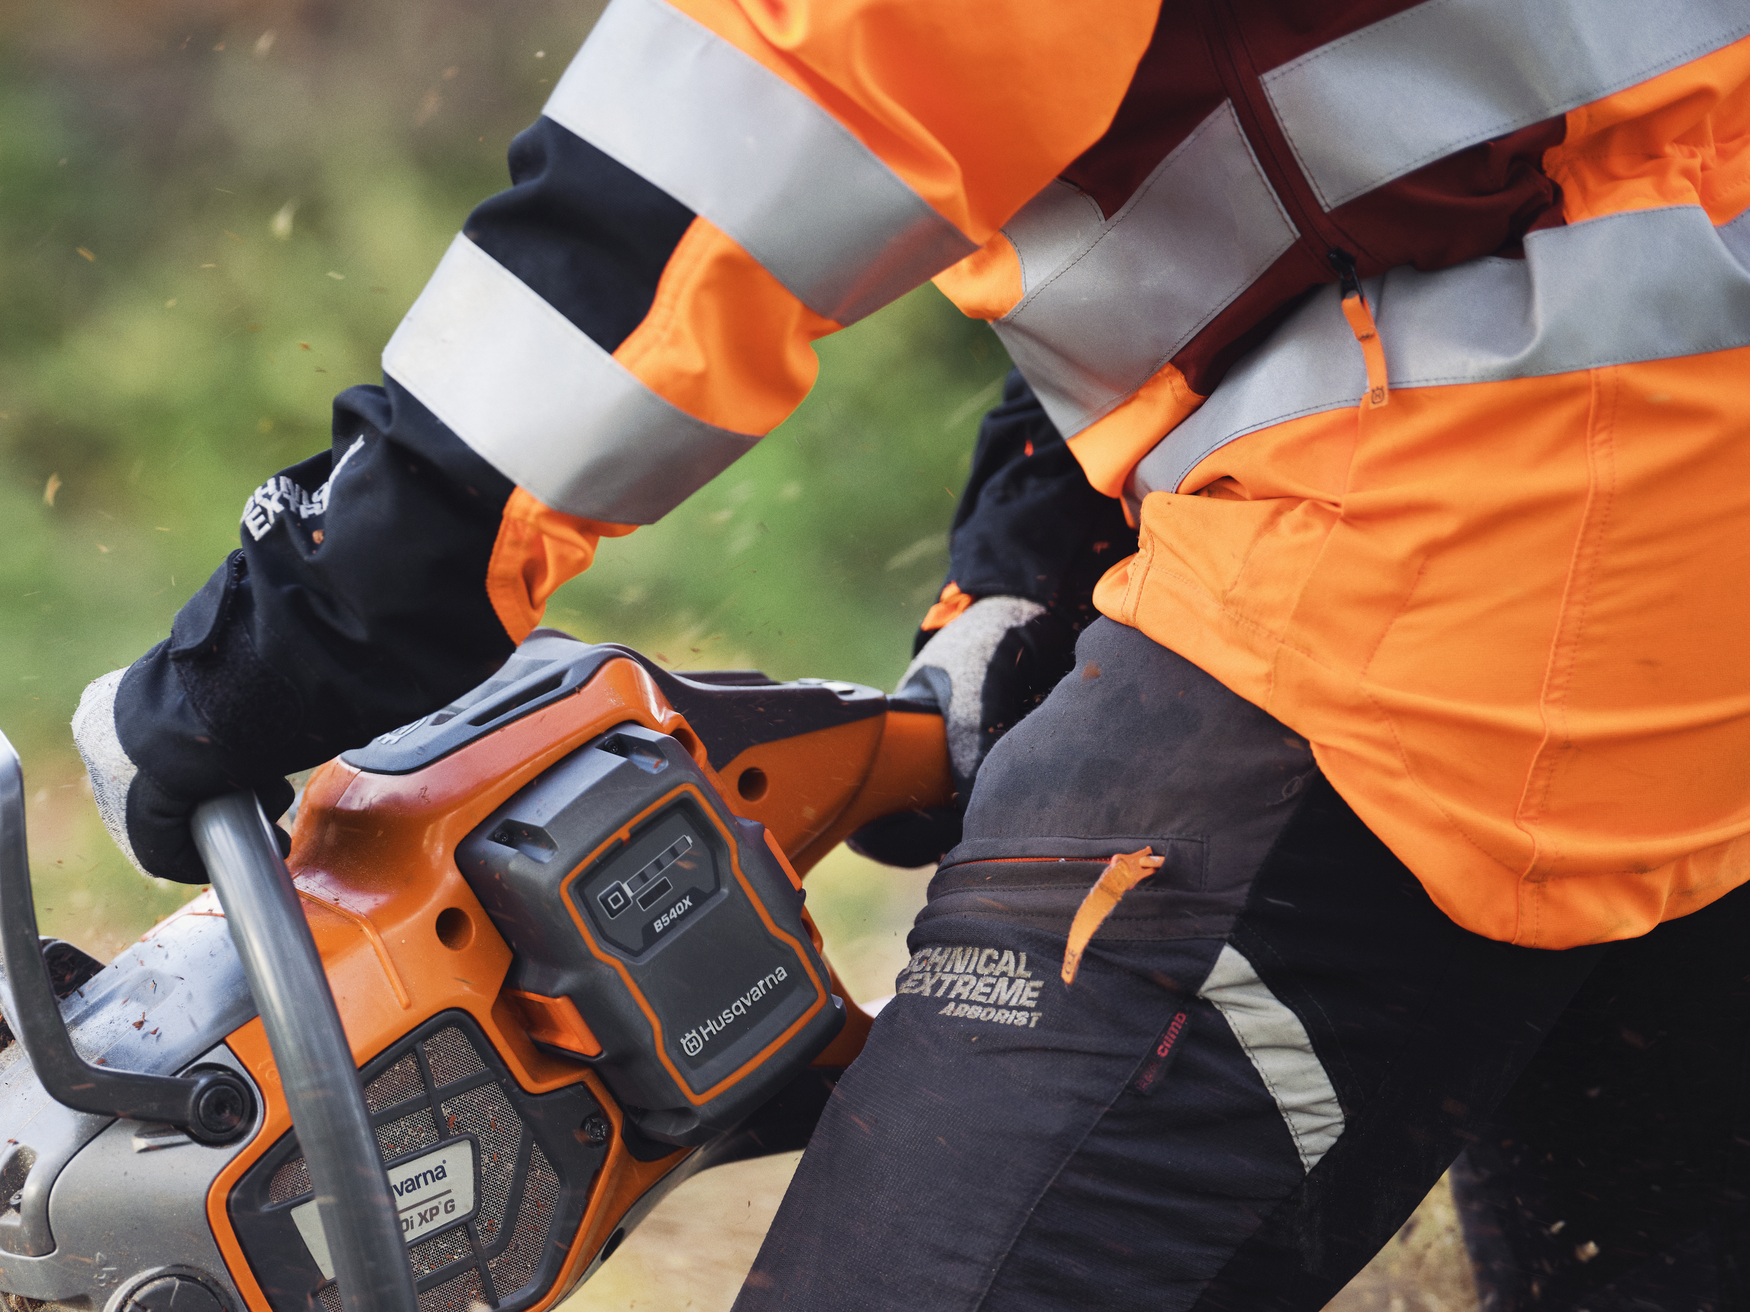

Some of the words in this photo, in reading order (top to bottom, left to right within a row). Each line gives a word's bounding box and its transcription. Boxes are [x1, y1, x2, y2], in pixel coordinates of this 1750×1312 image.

[653, 895, 693, 933] B540X
[903, 946, 1032, 978] CHNICAL
[699, 966, 788, 1041] Husqvarna
[899, 972, 1045, 1008] EXTREME
[938, 1001, 1043, 1028] ARBORIST
[391, 1164, 448, 1197] varna
[417, 1205, 440, 1227] XP
[444, 1198, 456, 1214] G
